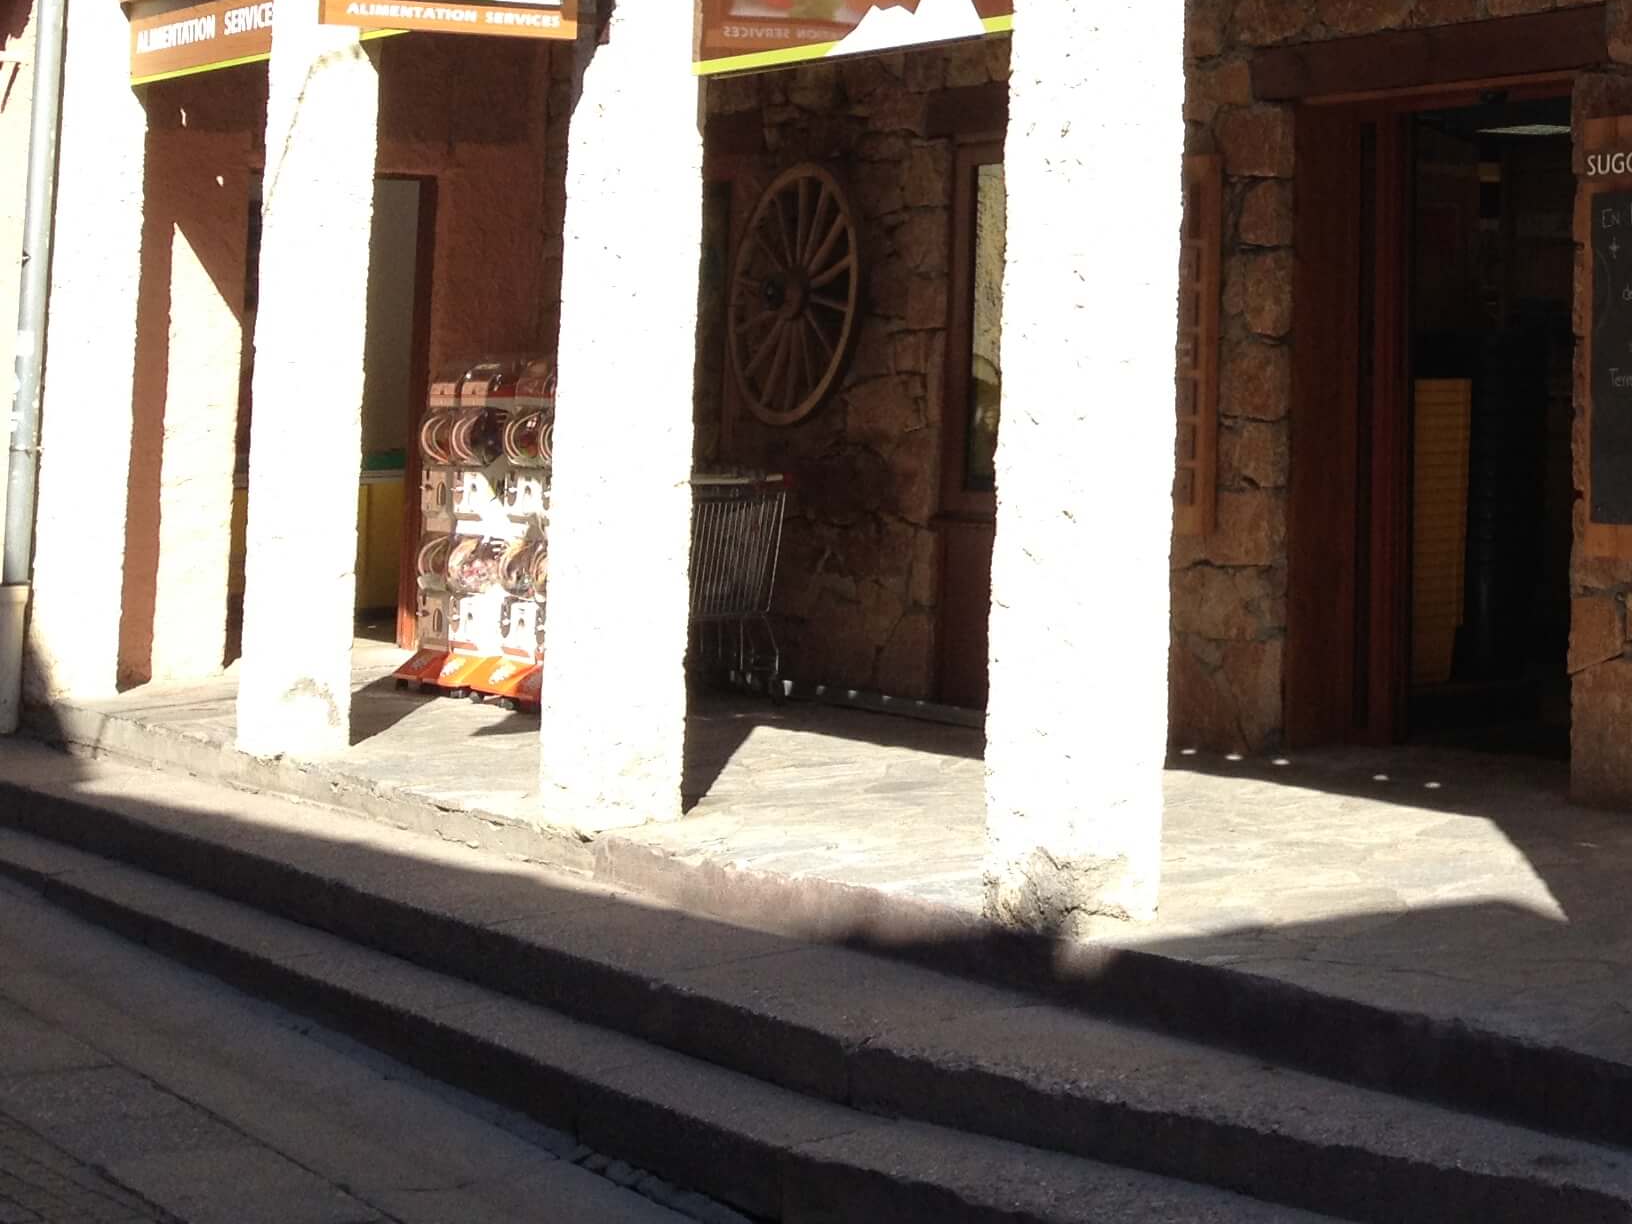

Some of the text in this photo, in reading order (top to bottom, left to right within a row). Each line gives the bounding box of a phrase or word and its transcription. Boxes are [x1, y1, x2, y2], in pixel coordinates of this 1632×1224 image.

[346, 2, 561, 29] ALIMENTATION SERVICES
[136, 14, 216, 55] ALIMENTATION
